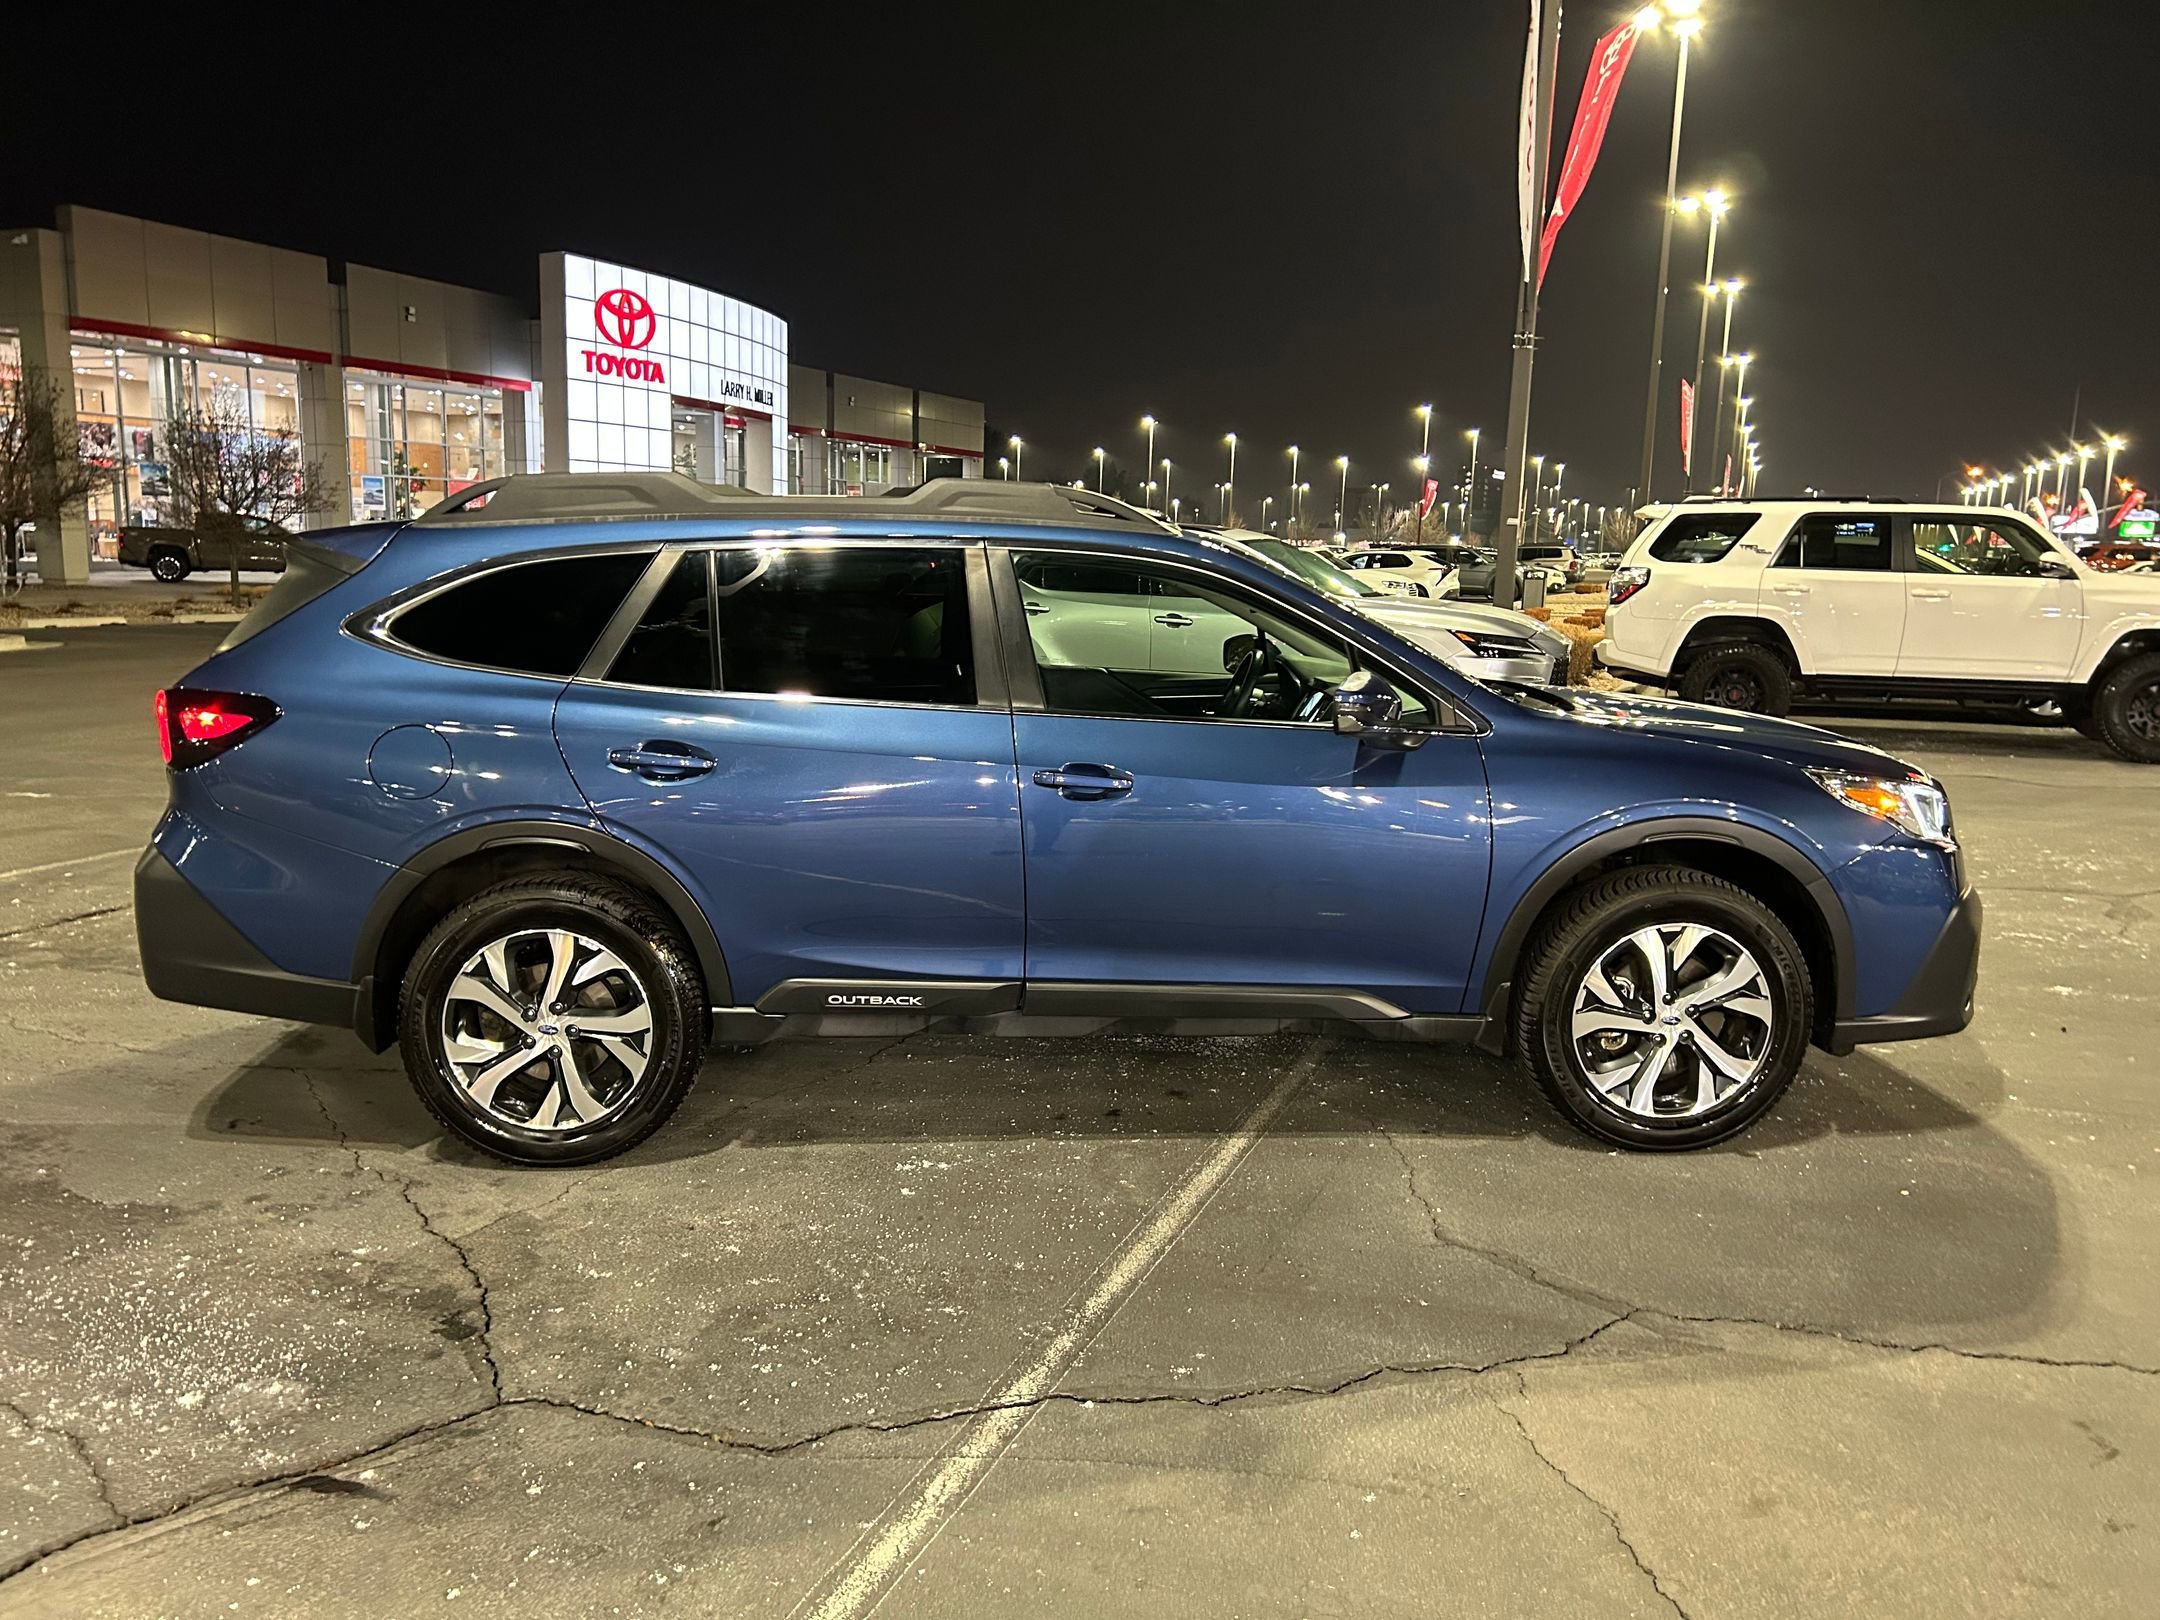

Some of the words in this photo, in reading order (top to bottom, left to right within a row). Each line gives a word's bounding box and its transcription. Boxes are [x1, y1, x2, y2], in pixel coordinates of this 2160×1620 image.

[581, 350, 665, 384] TOYOTA
[721, 379, 745, 400] LARRY
[746, 385, 753, 402] H.
[754, 387, 773, 407] MILLER
[827, 994, 923, 1006] OUTBACK
